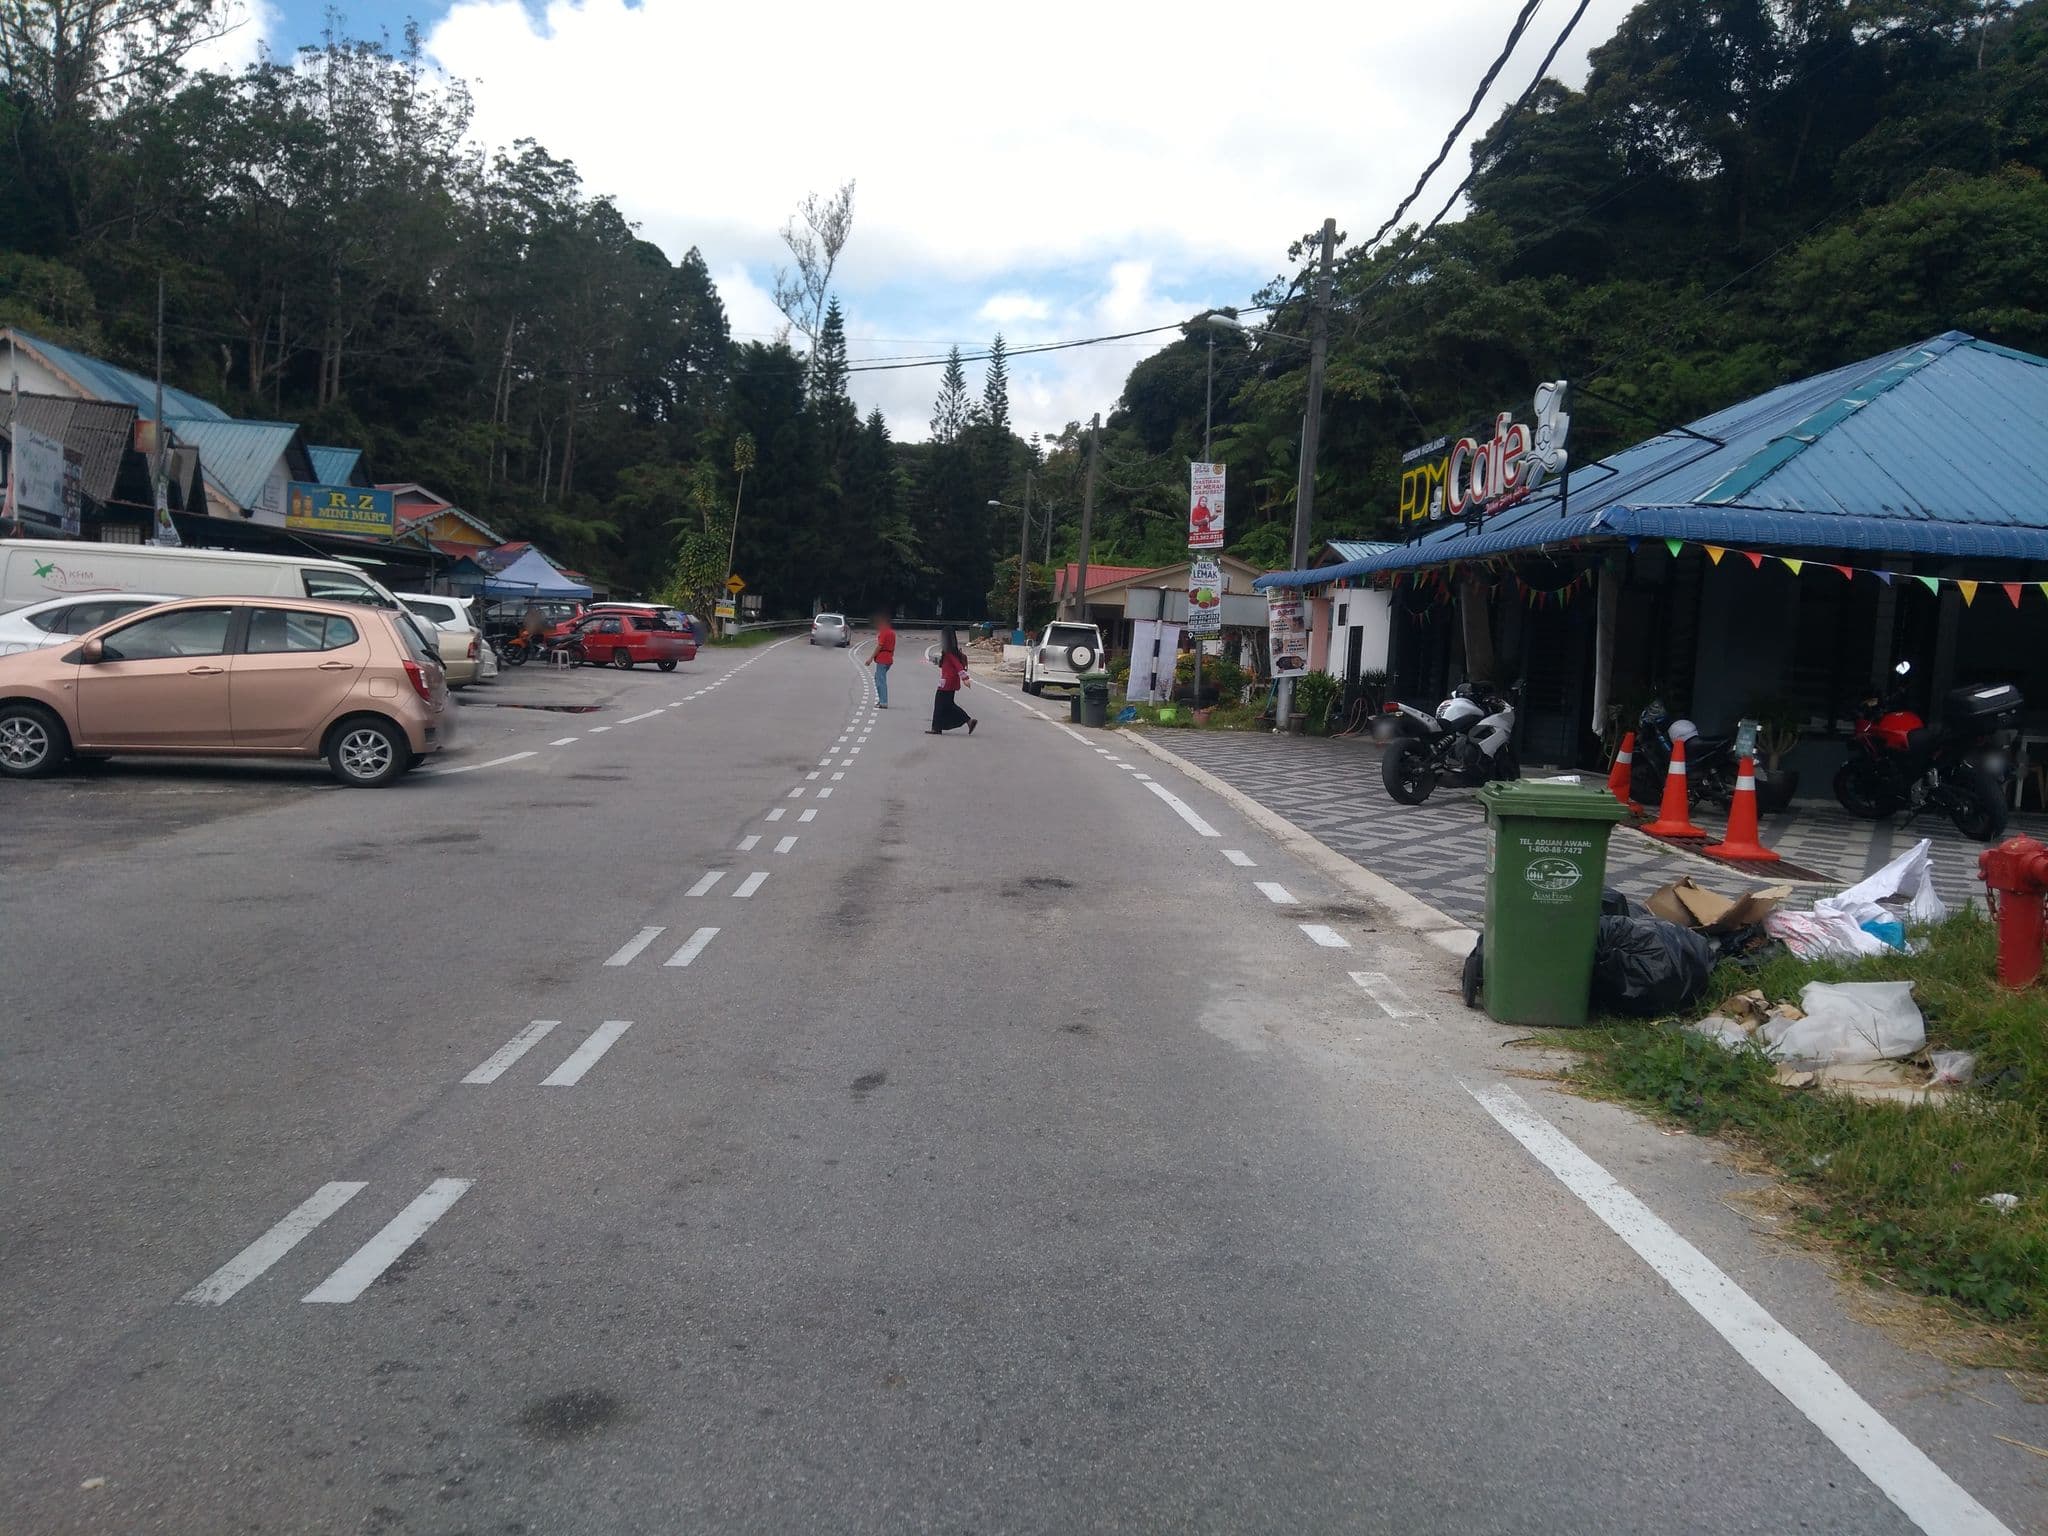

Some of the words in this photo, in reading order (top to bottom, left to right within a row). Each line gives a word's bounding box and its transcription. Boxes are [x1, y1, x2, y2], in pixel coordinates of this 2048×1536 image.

[1400, 456, 1449, 523] PDM
[1448, 411, 1531, 515] Cafe
[318, 508, 349, 519] MINI
[351, 510, 387, 523] MART
[1193, 569, 1218, 579] LEMAK
